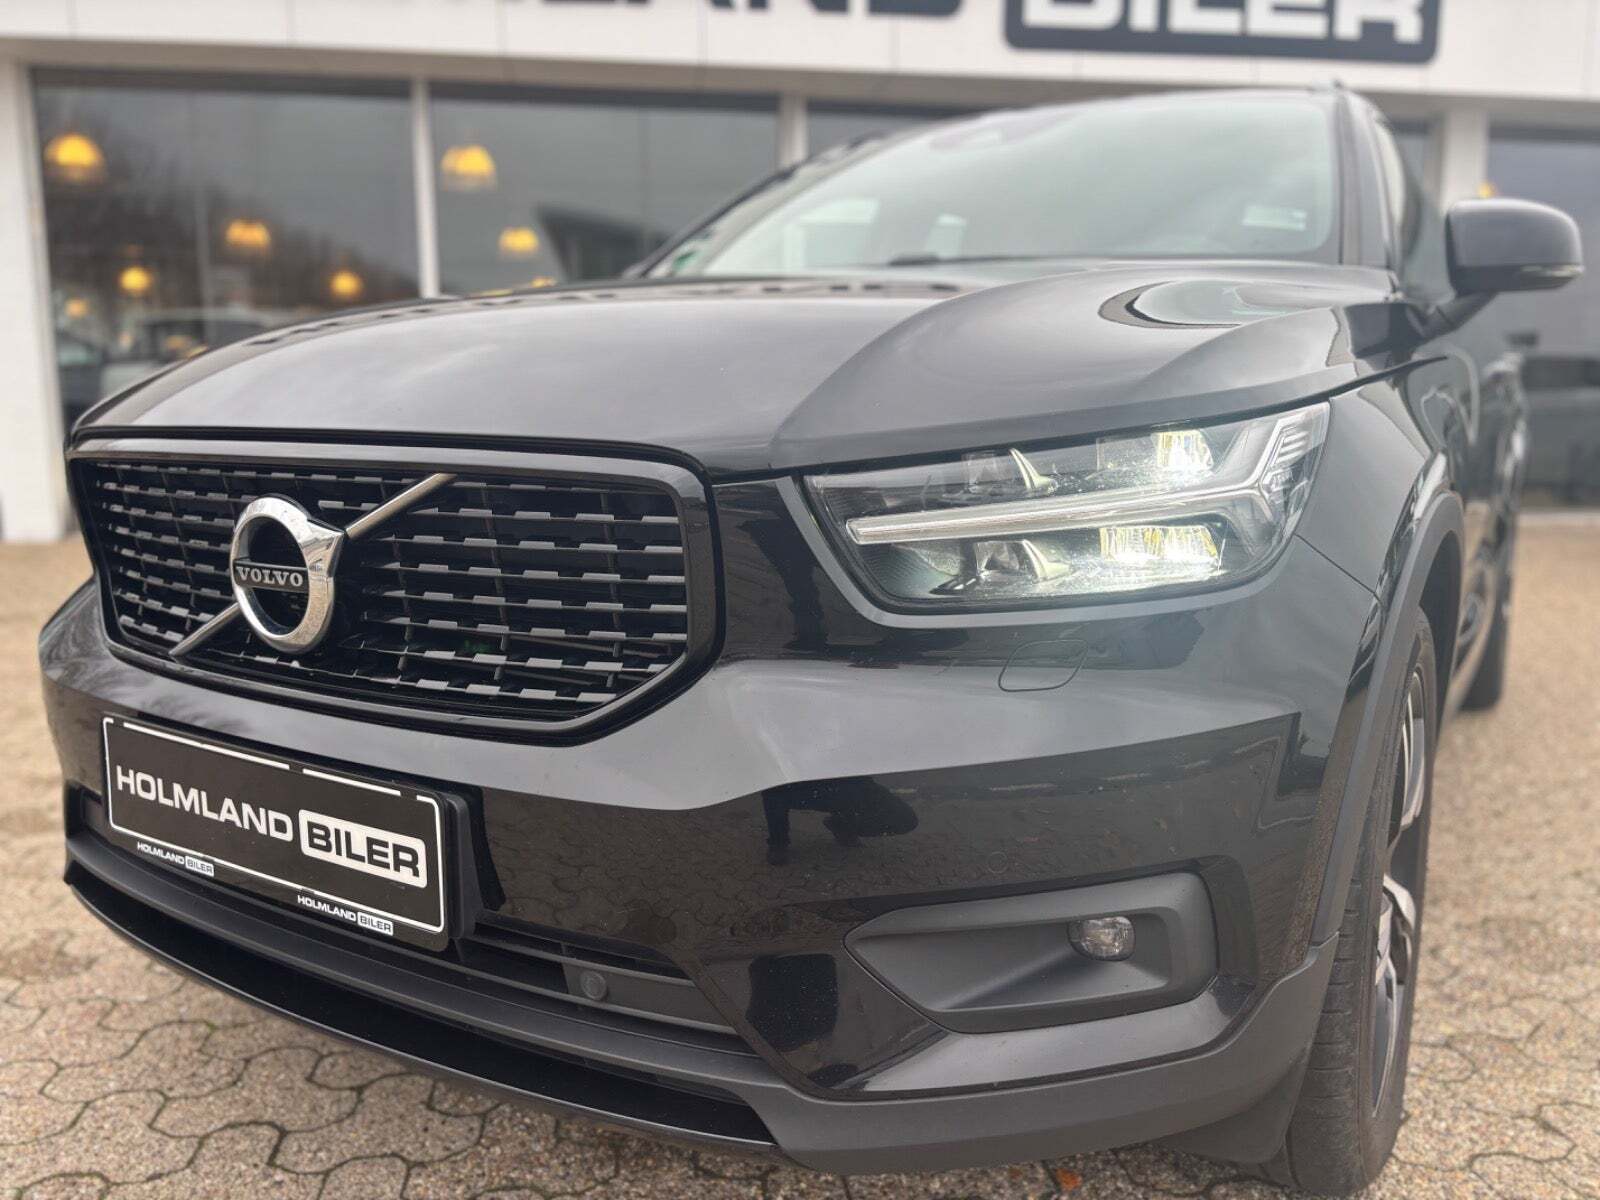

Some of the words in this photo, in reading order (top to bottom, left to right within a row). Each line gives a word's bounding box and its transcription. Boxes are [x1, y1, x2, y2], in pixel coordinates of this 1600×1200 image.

[236, 566, 303, 587] VOLVO
[116, 766, 294, 842] HOLMLAND
[308, 823, 420, 878] BILER
[138, 842, 185, 865] HOLMLAND
[187, 858, 213, 875] BILER
[297, 895, 356, 922] HOLMLAND
[360, 915, 392, 933] BILER
